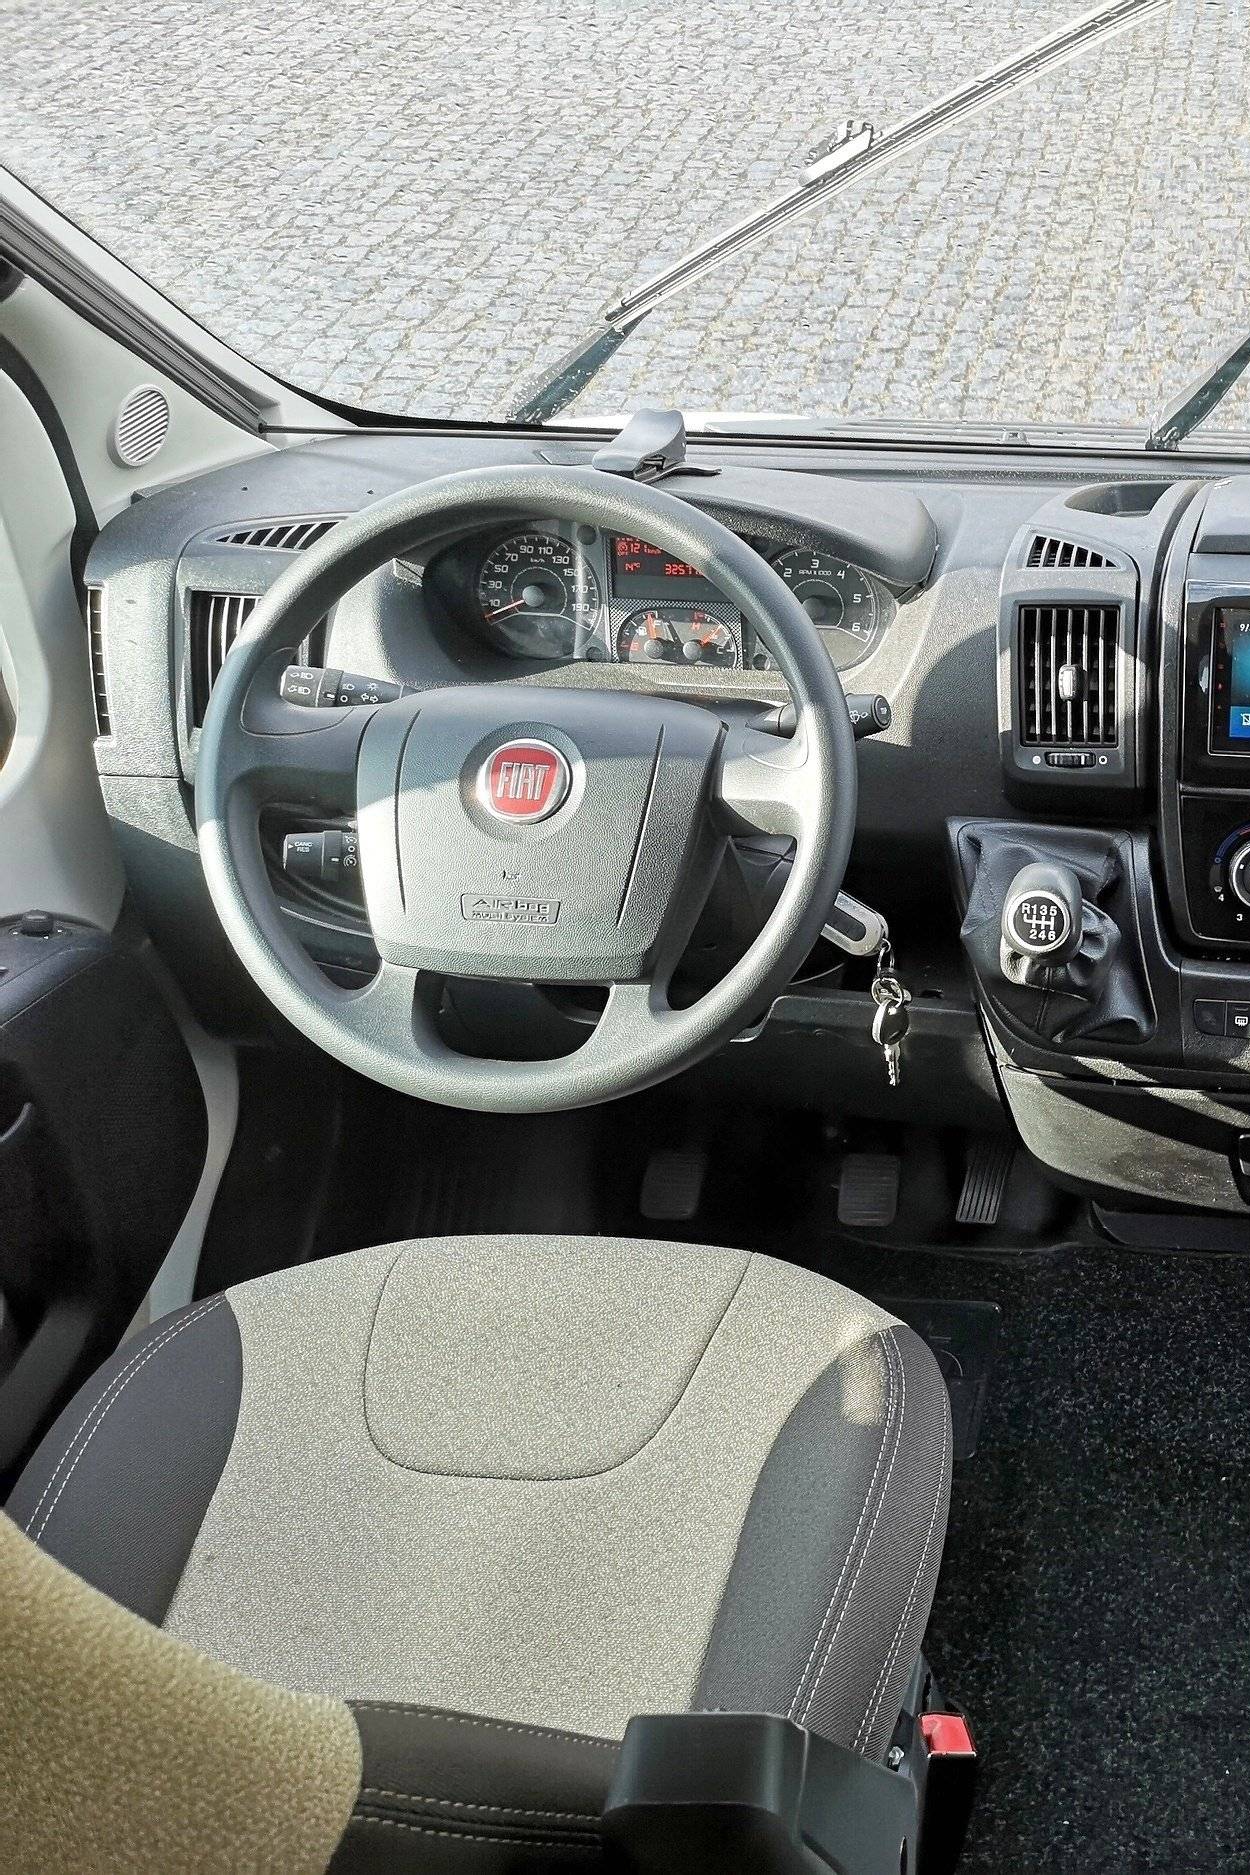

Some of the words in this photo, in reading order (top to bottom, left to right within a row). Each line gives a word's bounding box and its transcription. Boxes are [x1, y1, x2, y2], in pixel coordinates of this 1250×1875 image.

[520, 545, 534, 554] 90
[539, 546, 553, 555] 110
[505, 553, 519, 562] 70
[552, 556, 570, 564] 130
[810, 559, 820, 568] 3
[494, 564, 509, 573] 50
[562, 568, 581, 577] 150
[783, 568, 792, 578] 2
[837, 570, 846, 579] 4
[488, 581, 502, 589] 30
[571, 585, 589, 594] 170
[488, 599, 500, 607] 10
[853, 594, 862, 603] 5
[571, 603, 590, 612] 190
[852, 623, 860, 632] 6
[496, 761, 551, 801] FIAT
[1218, 893, 1225, 902] 4
[1236, 913, 1243, 922] 3
